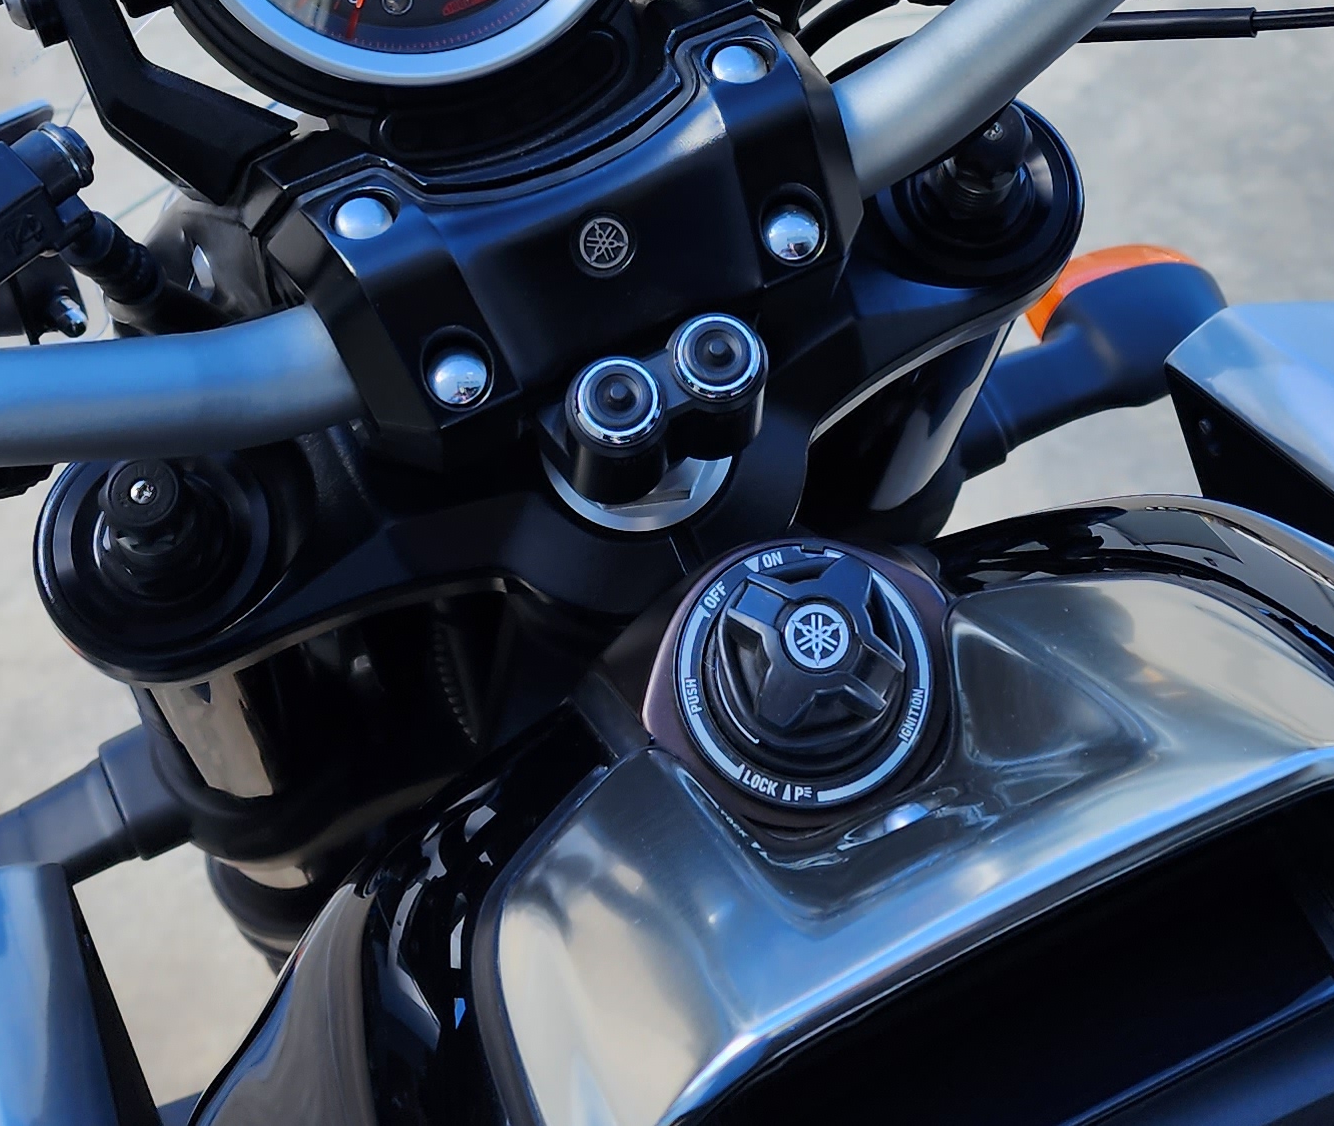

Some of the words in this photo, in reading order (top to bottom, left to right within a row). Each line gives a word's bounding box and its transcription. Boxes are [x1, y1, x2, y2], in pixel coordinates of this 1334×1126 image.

[761, 551, 784, 569] ON
[703, 580, 728, 610] OFF
[685, 677, 702, 716] PUSH
[898, 687, 925, 744] IGNITION
[742, 766, 778, 797] LOCK
